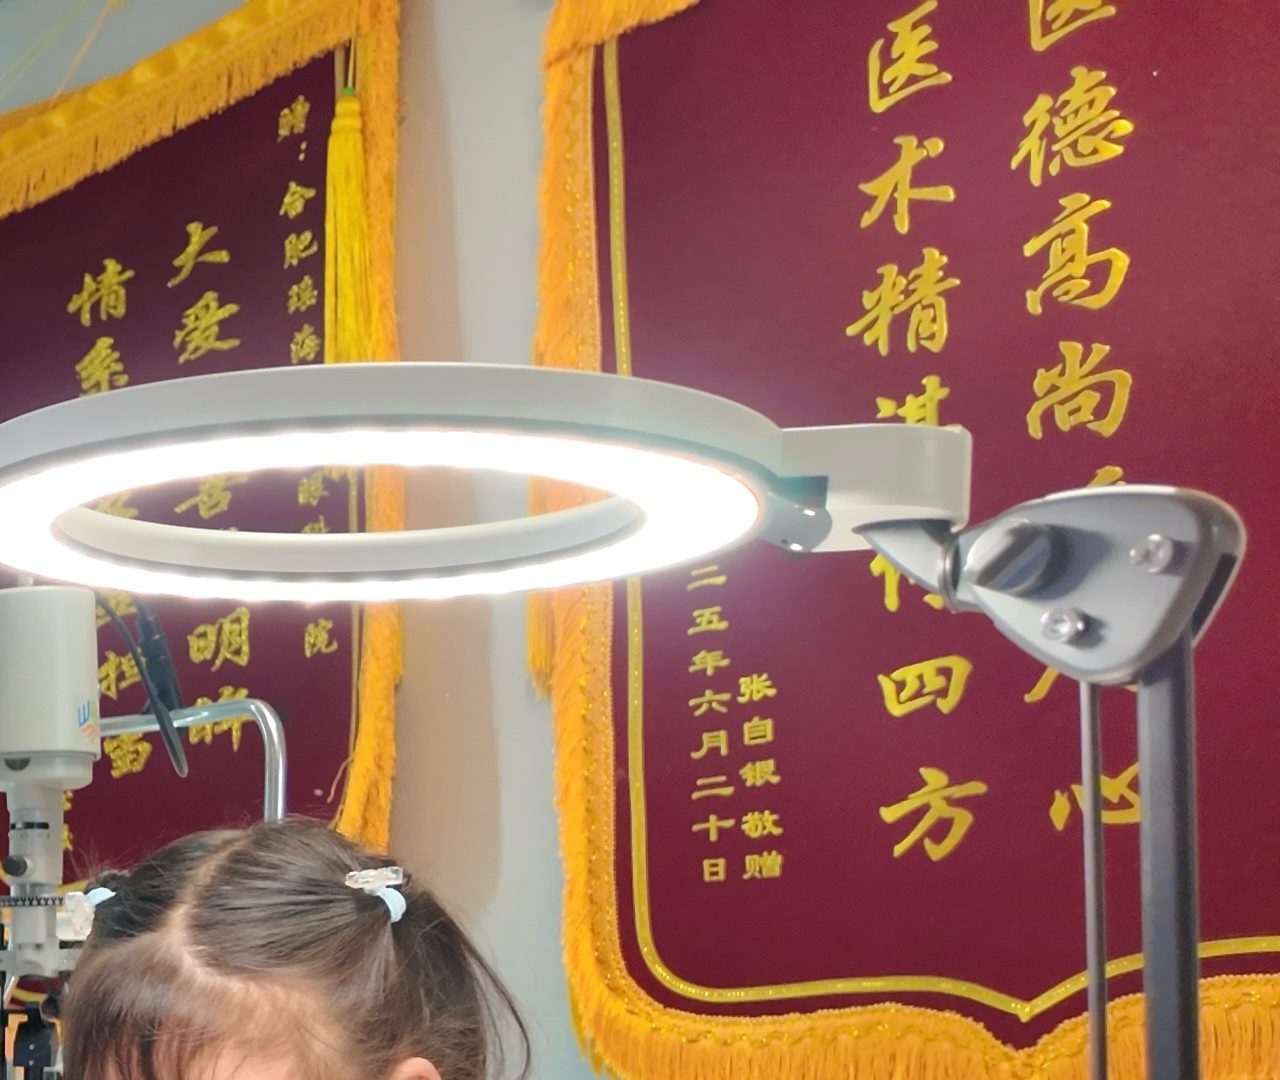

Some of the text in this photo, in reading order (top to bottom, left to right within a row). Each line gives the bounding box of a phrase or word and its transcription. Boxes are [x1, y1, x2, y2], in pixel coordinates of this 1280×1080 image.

[737, 672, 784, 881] 张自银敬赠
